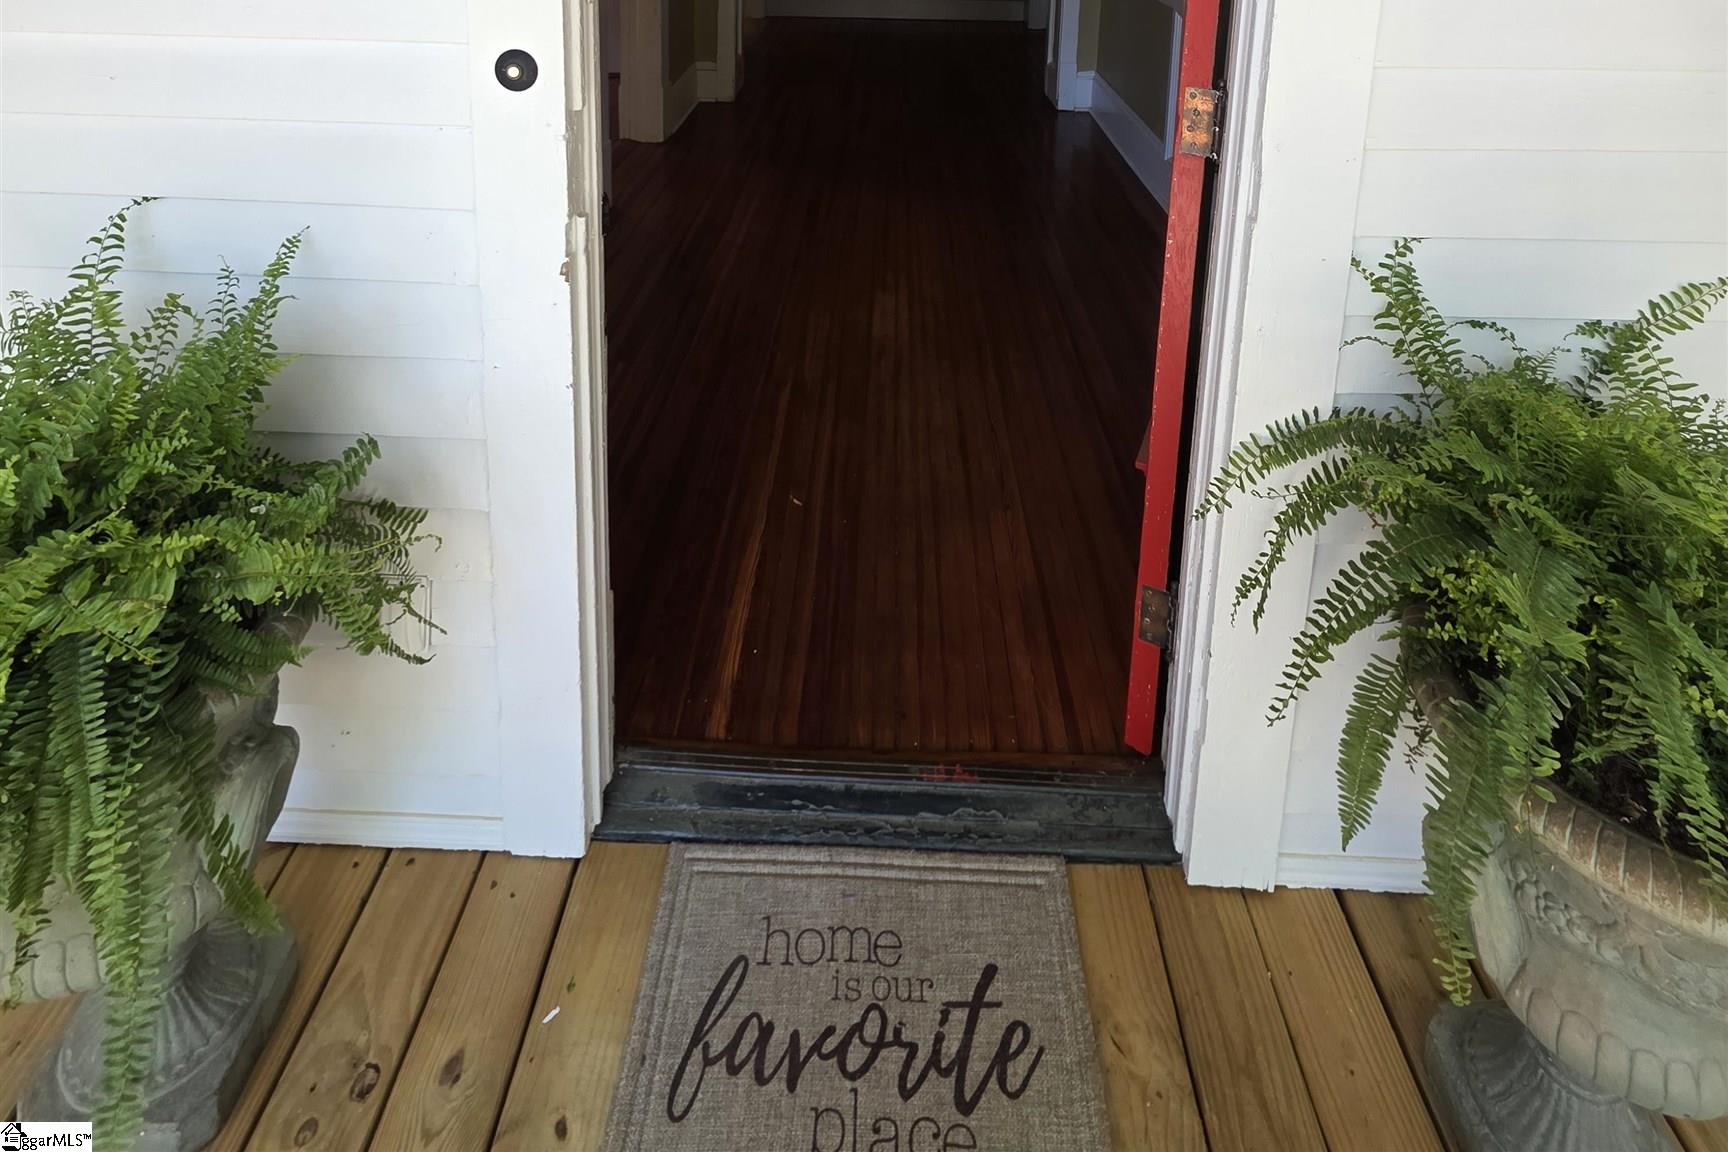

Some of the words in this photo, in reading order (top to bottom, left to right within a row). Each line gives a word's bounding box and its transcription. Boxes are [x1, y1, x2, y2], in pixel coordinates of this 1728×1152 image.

[755, 915, 903, 968] home
[831, 969, 862, 1002] is
[871, 973, 934, 1004] our
[666, 953, 1045, 1123] favorite
[810, 1087, 977, 1152] place
